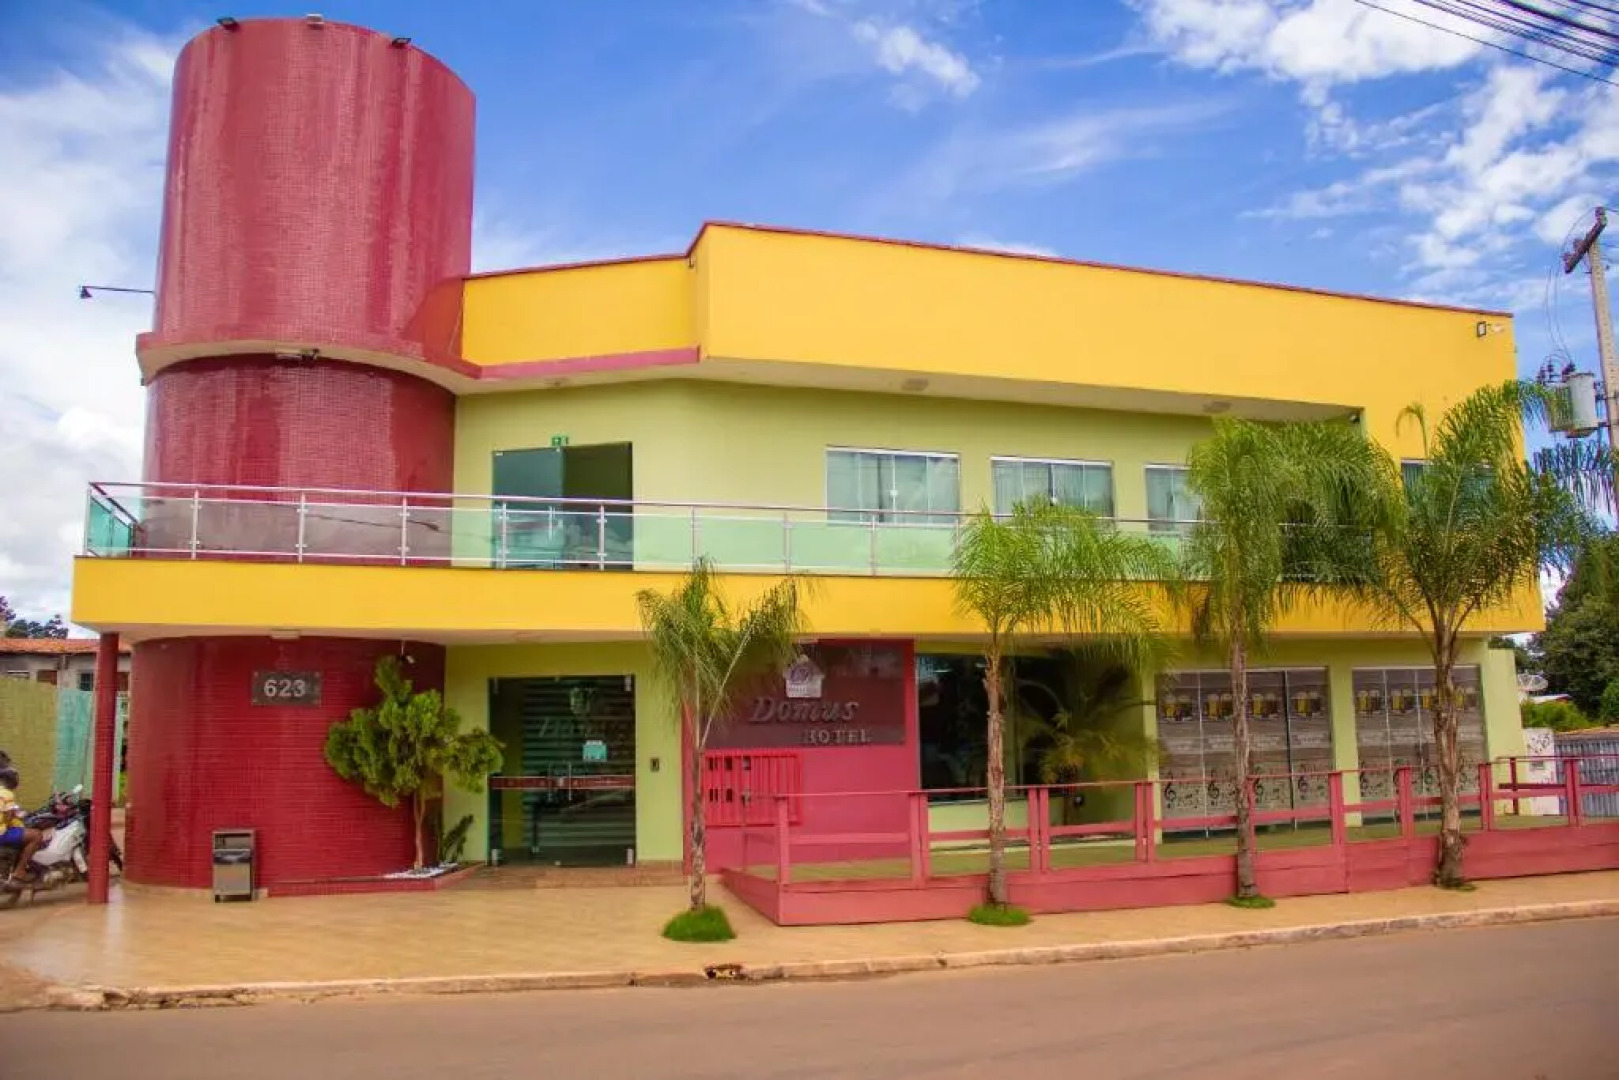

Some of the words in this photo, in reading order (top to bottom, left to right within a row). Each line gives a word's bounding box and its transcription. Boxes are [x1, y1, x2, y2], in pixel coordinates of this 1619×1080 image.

[263, 679, 306, 697] 623
[750, 696, 859, 723] Domus
[803, 728, 872, 744] HOTEL
